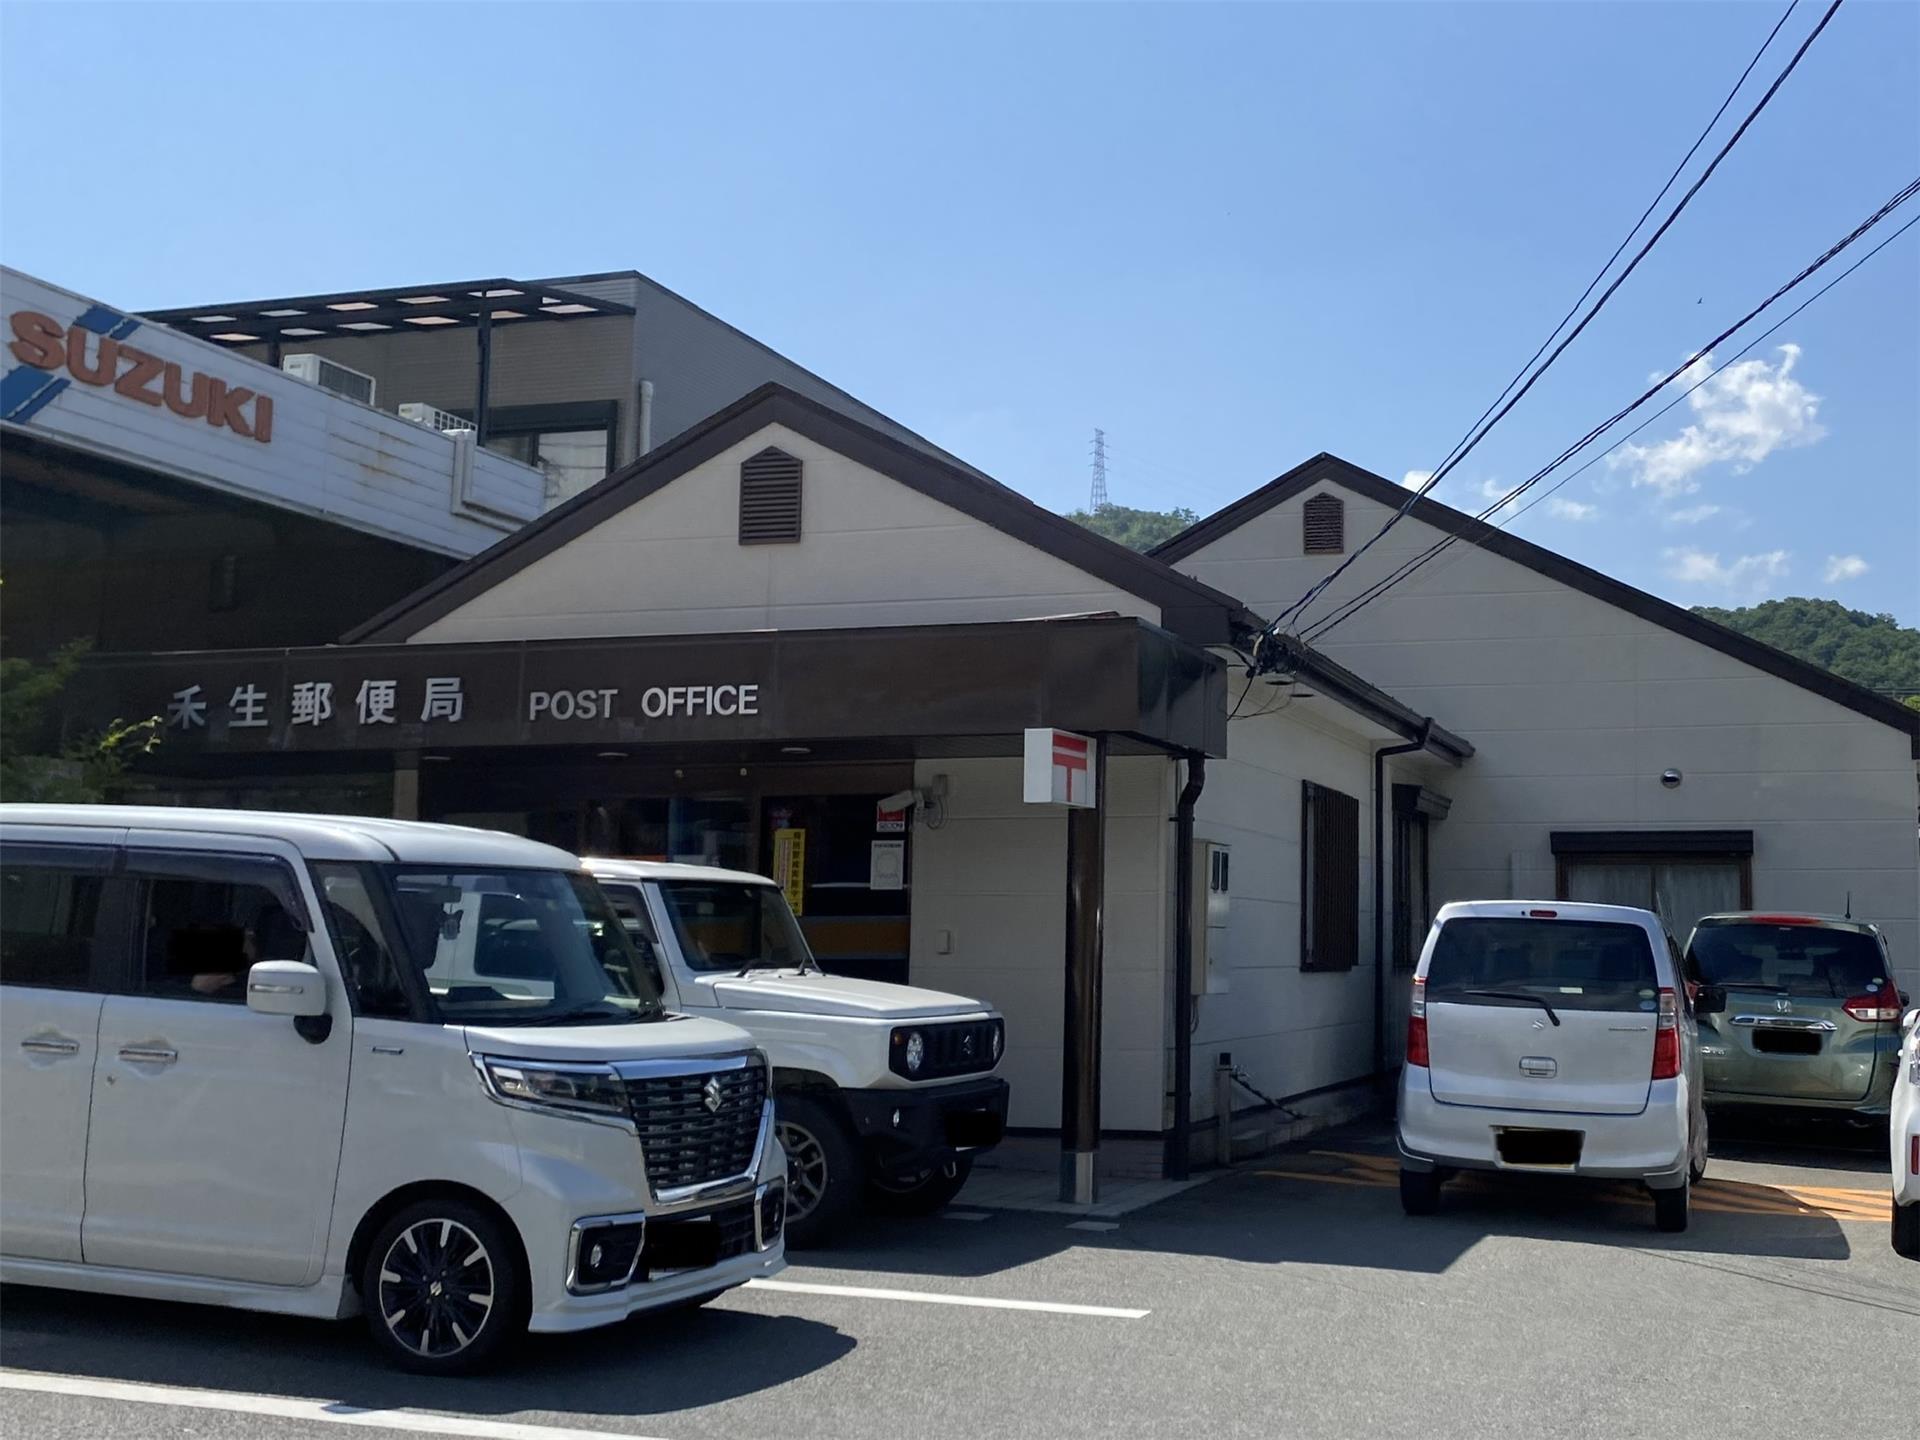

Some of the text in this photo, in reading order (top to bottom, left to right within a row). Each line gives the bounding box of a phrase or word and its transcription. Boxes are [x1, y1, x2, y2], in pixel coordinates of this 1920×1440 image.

[9, 310, 273, 443] SUZUKI
[167, 677, 463, 729] 禾生郵便局
[529, 685, 758, 720] POST OFFICE
